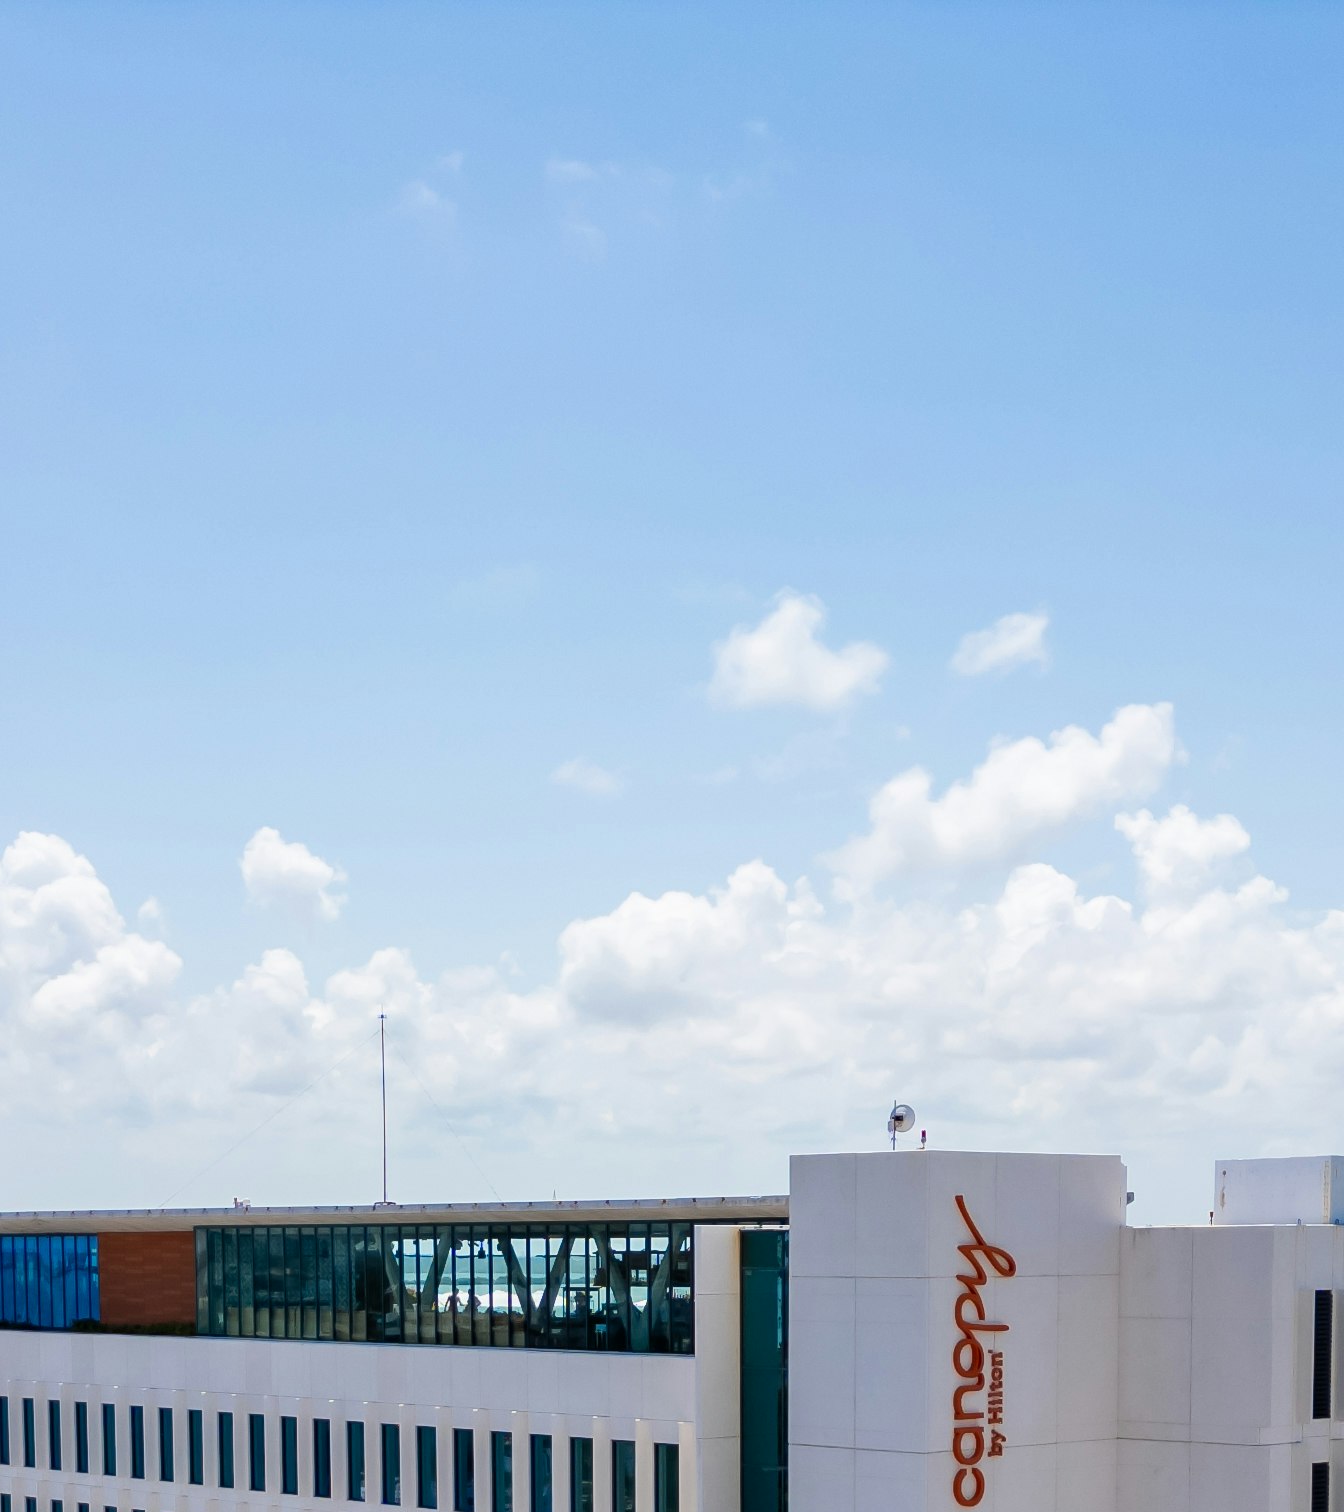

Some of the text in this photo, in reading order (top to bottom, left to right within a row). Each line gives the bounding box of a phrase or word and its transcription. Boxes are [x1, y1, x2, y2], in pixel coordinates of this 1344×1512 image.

[952, 1194, 1017, 1507] canopy
[987, 1349, 1007, 1458] by Hilton
